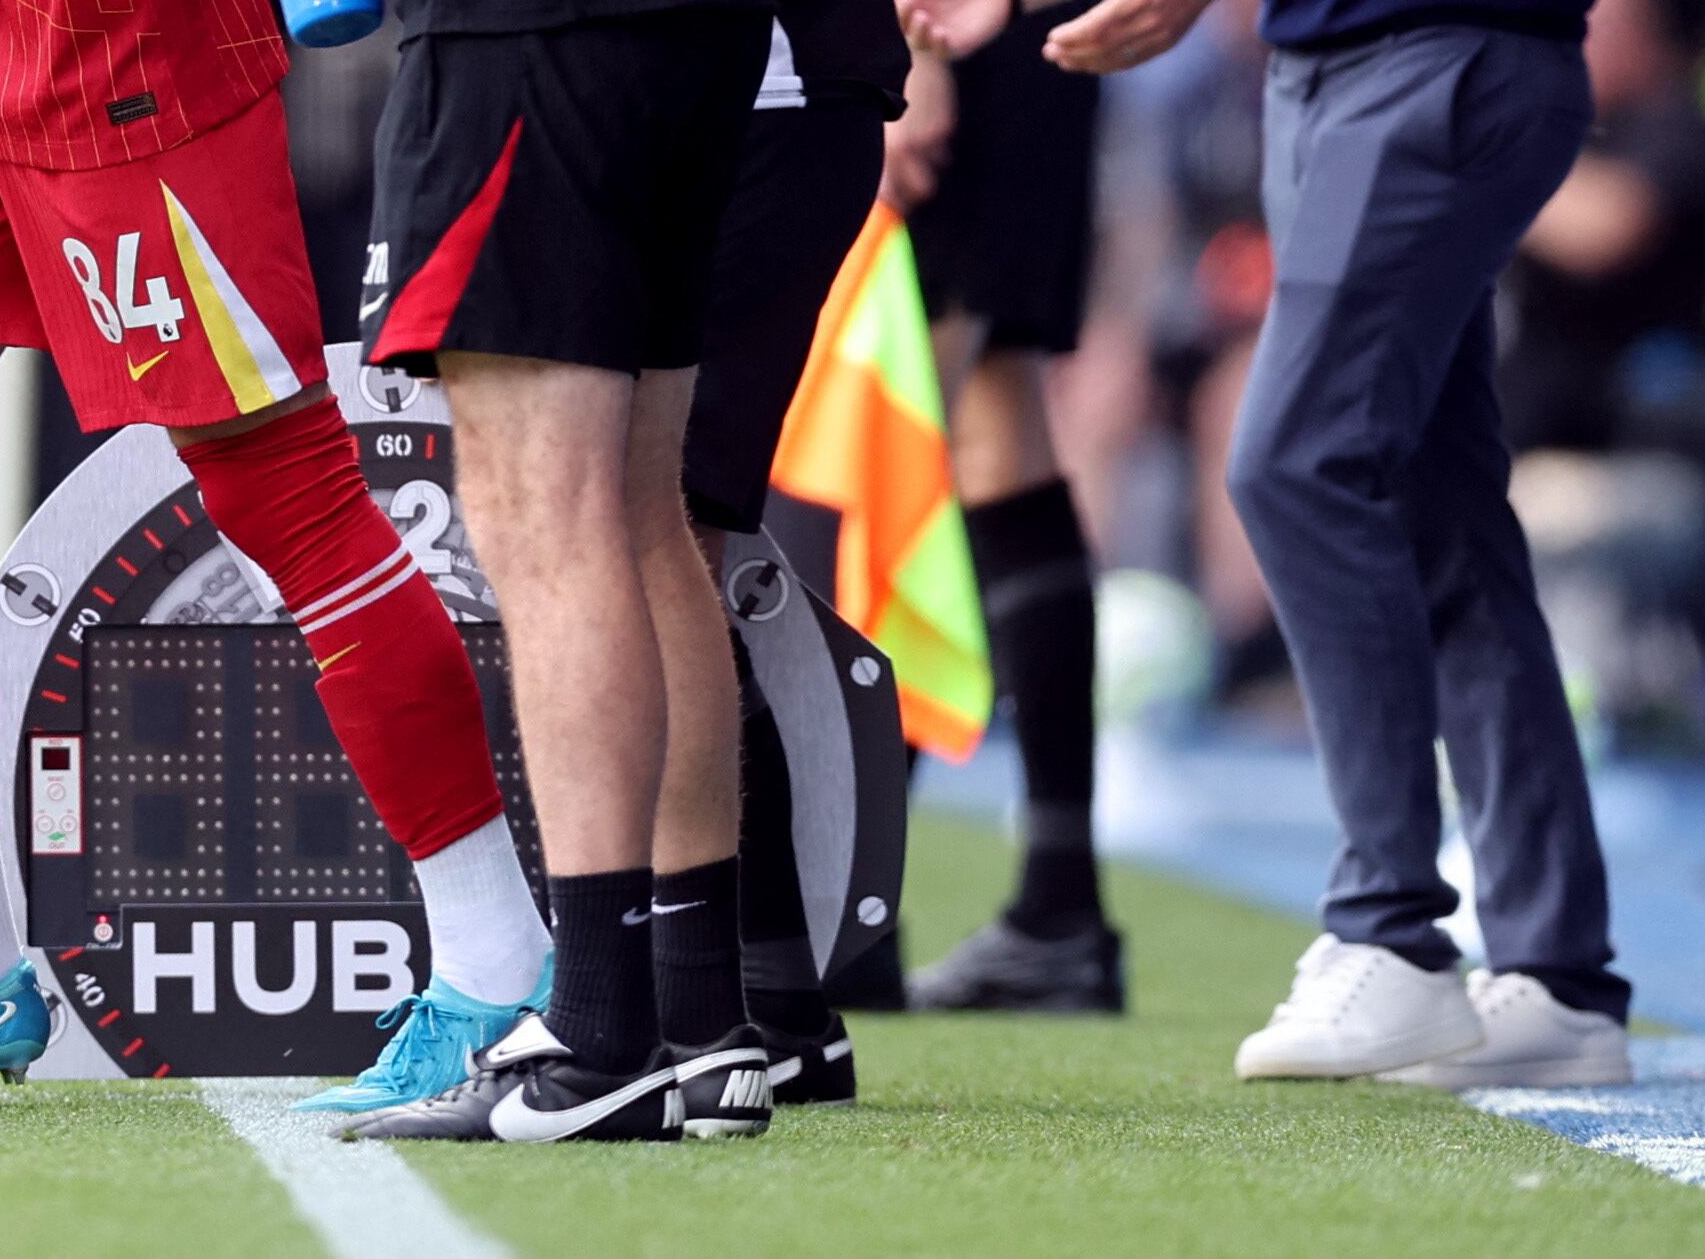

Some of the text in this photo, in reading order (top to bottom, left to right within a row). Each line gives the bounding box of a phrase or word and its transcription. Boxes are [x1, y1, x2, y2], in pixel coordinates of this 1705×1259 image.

[62, 231, 185, 344] 84
[375, 433, 413, 457] 60
[74, 972, 106, 1008] 40
